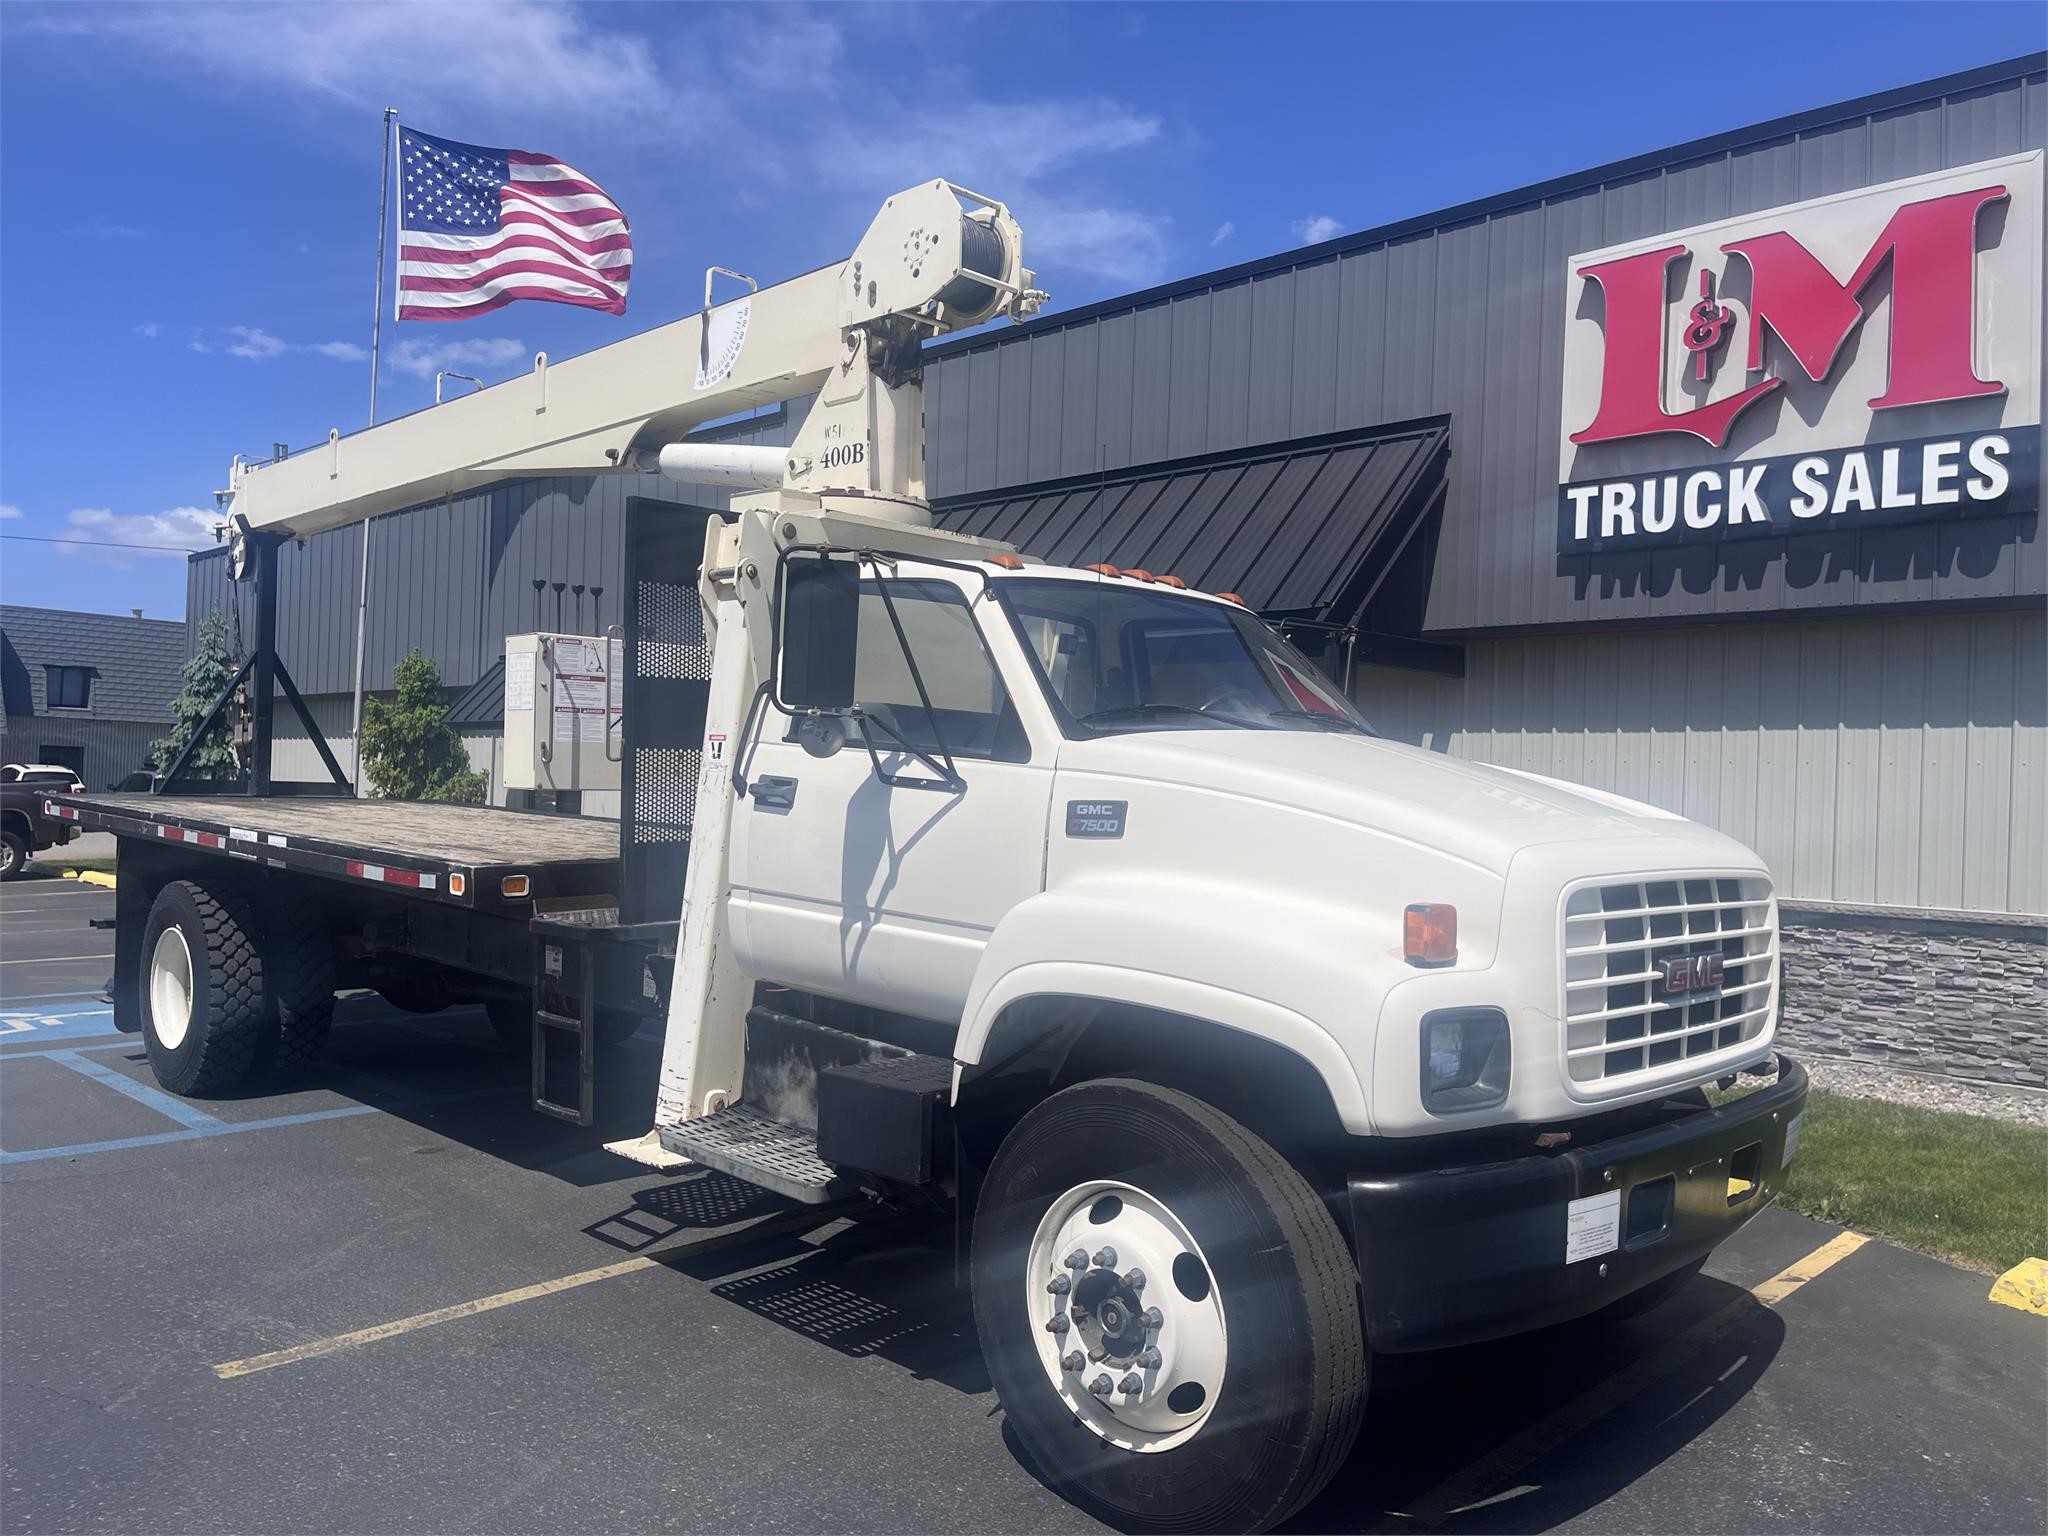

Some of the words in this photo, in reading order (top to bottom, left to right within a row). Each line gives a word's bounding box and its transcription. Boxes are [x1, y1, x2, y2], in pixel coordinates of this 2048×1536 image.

[820, 443, 864, 468] 400B
[1567, 464, 1768, 540] TRUCK
[1790, 435, 2010, 518] SALES
[1077, 805, 1113, 815] GMC
[1080, 819, 1118, 832] 7500
[1666, 952, 1724, 992] GMC
